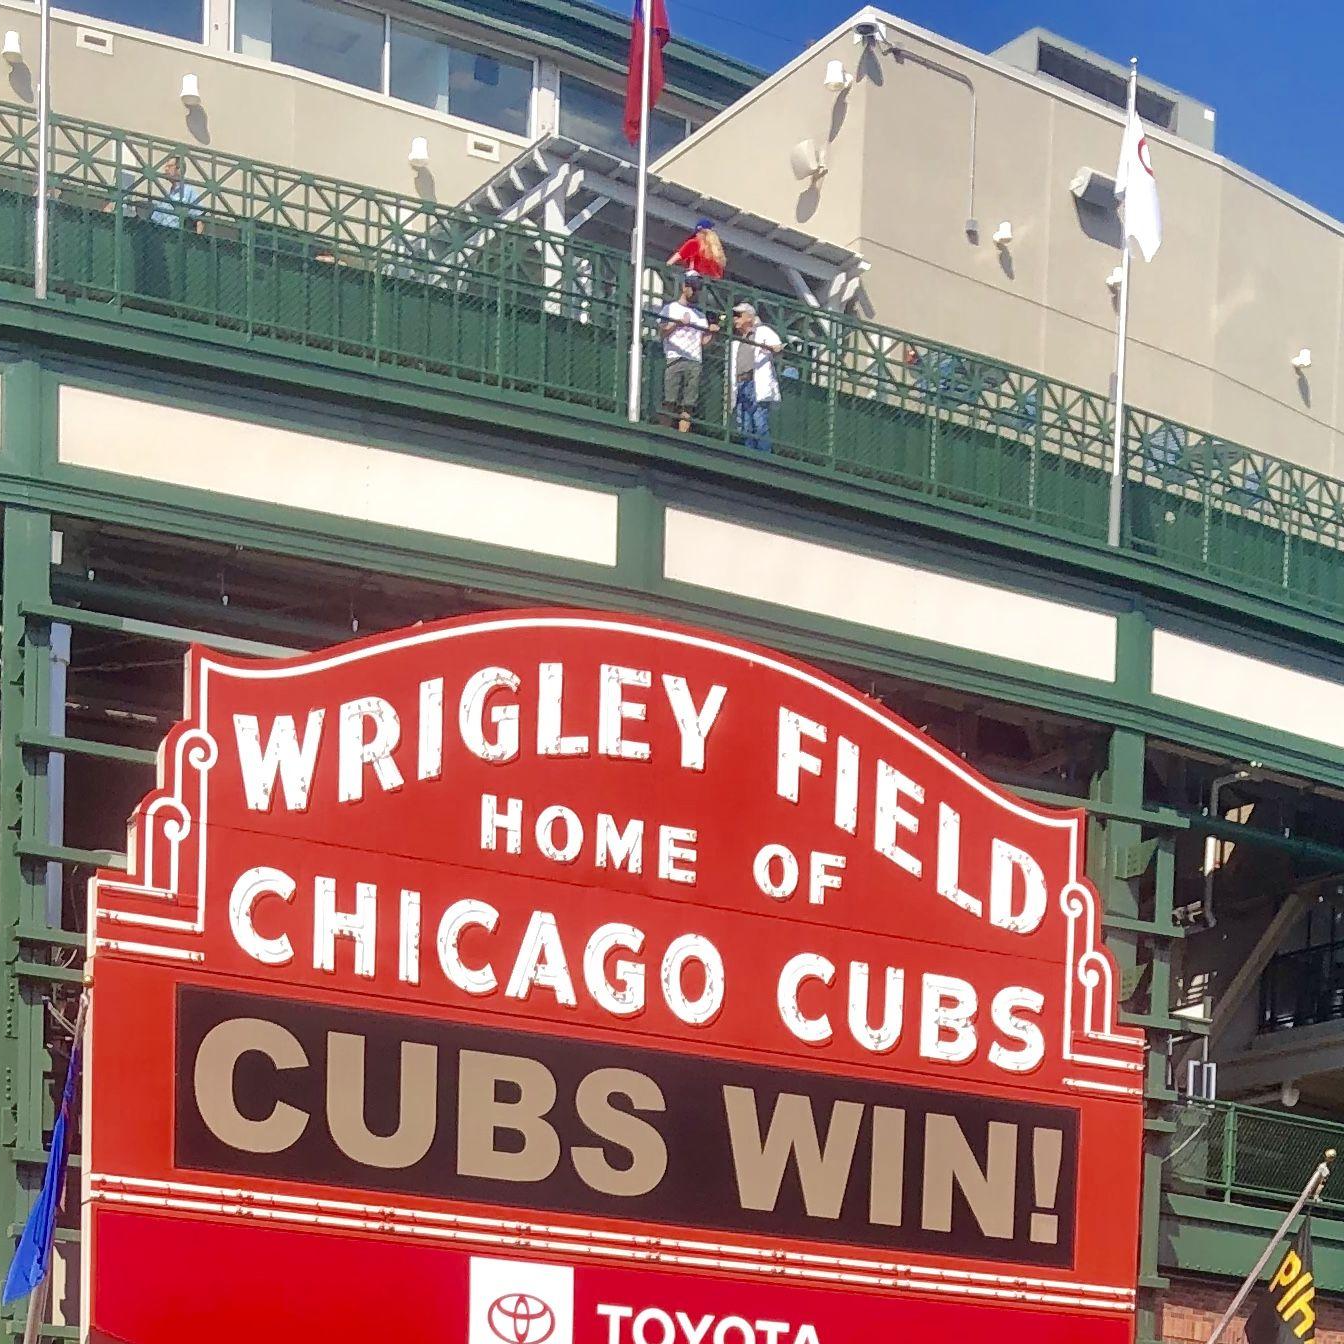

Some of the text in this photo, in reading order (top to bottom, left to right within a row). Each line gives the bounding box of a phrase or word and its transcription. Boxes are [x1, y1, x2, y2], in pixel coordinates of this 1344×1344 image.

[233, 662, 1048, 935] WRIGLEY FIELD
[479, 794, 847, 905] HOME OF
[228, 867, 1047, 1073] CHICAGO CUBS
[193, 1018, 1063, 1244] CUBS WIN!
